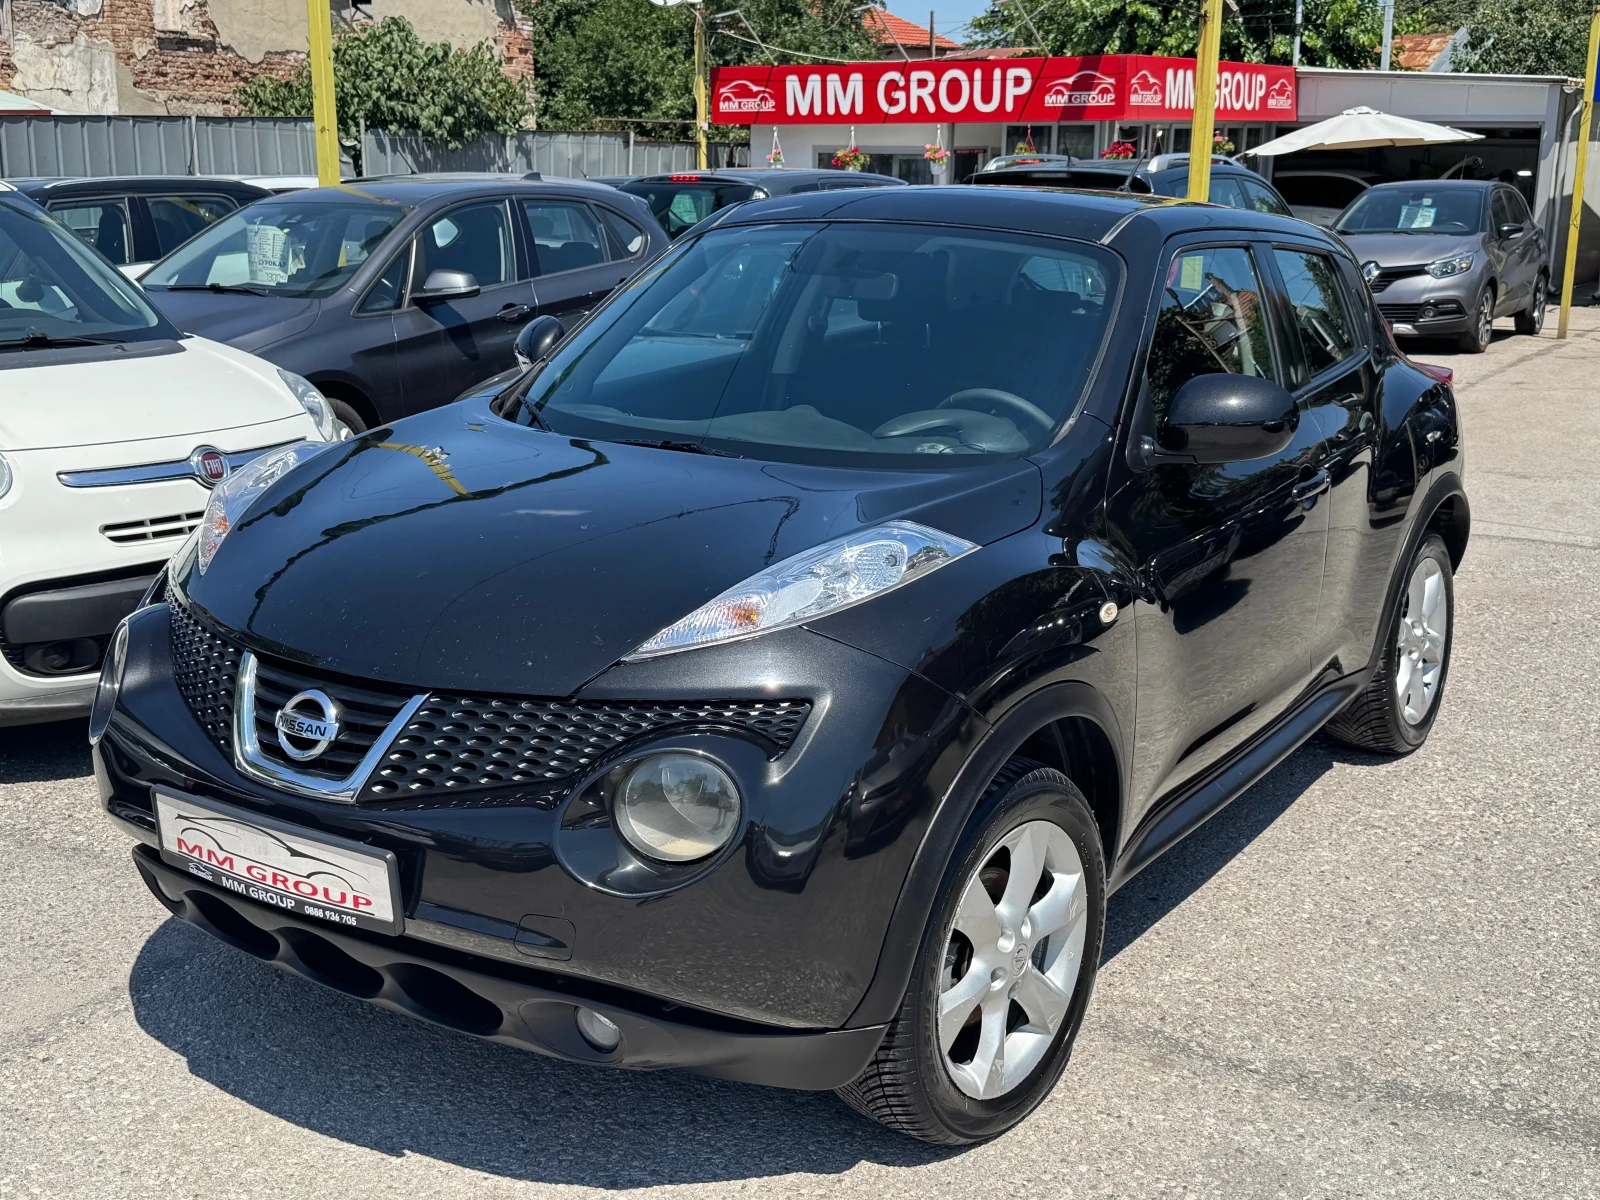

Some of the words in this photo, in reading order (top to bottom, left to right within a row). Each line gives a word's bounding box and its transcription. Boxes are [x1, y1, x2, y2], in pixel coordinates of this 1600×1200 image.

[785, 73, 864, 116] MM
[876, 67, 1033, 115] GROUP
[1044, 94, 1069, 104] MM
[1071, 93, 1116, 104] GROUP
[1129, 94, 1142, 103] MM
[1142, 94, 1162, 103] GROUP
[719, 101, 739, 110] MM
[741, 101, 776, 110] GROUP
[1276, 98, 1292, 106] GROUP
[204, 458, 223, 475] FIAT
[279, 713, 328, 737] NISSAN
[177, 836, 235, 871] MM
[245, 865, 373, 909] GROUP
[221, 875, 247, 895] MM
[248, 886, 296, 910] GROUP
[304, 905, 324, 918] 0888
[325, 910, 340, 922] 936
[341, 914, 357, 926] 705
